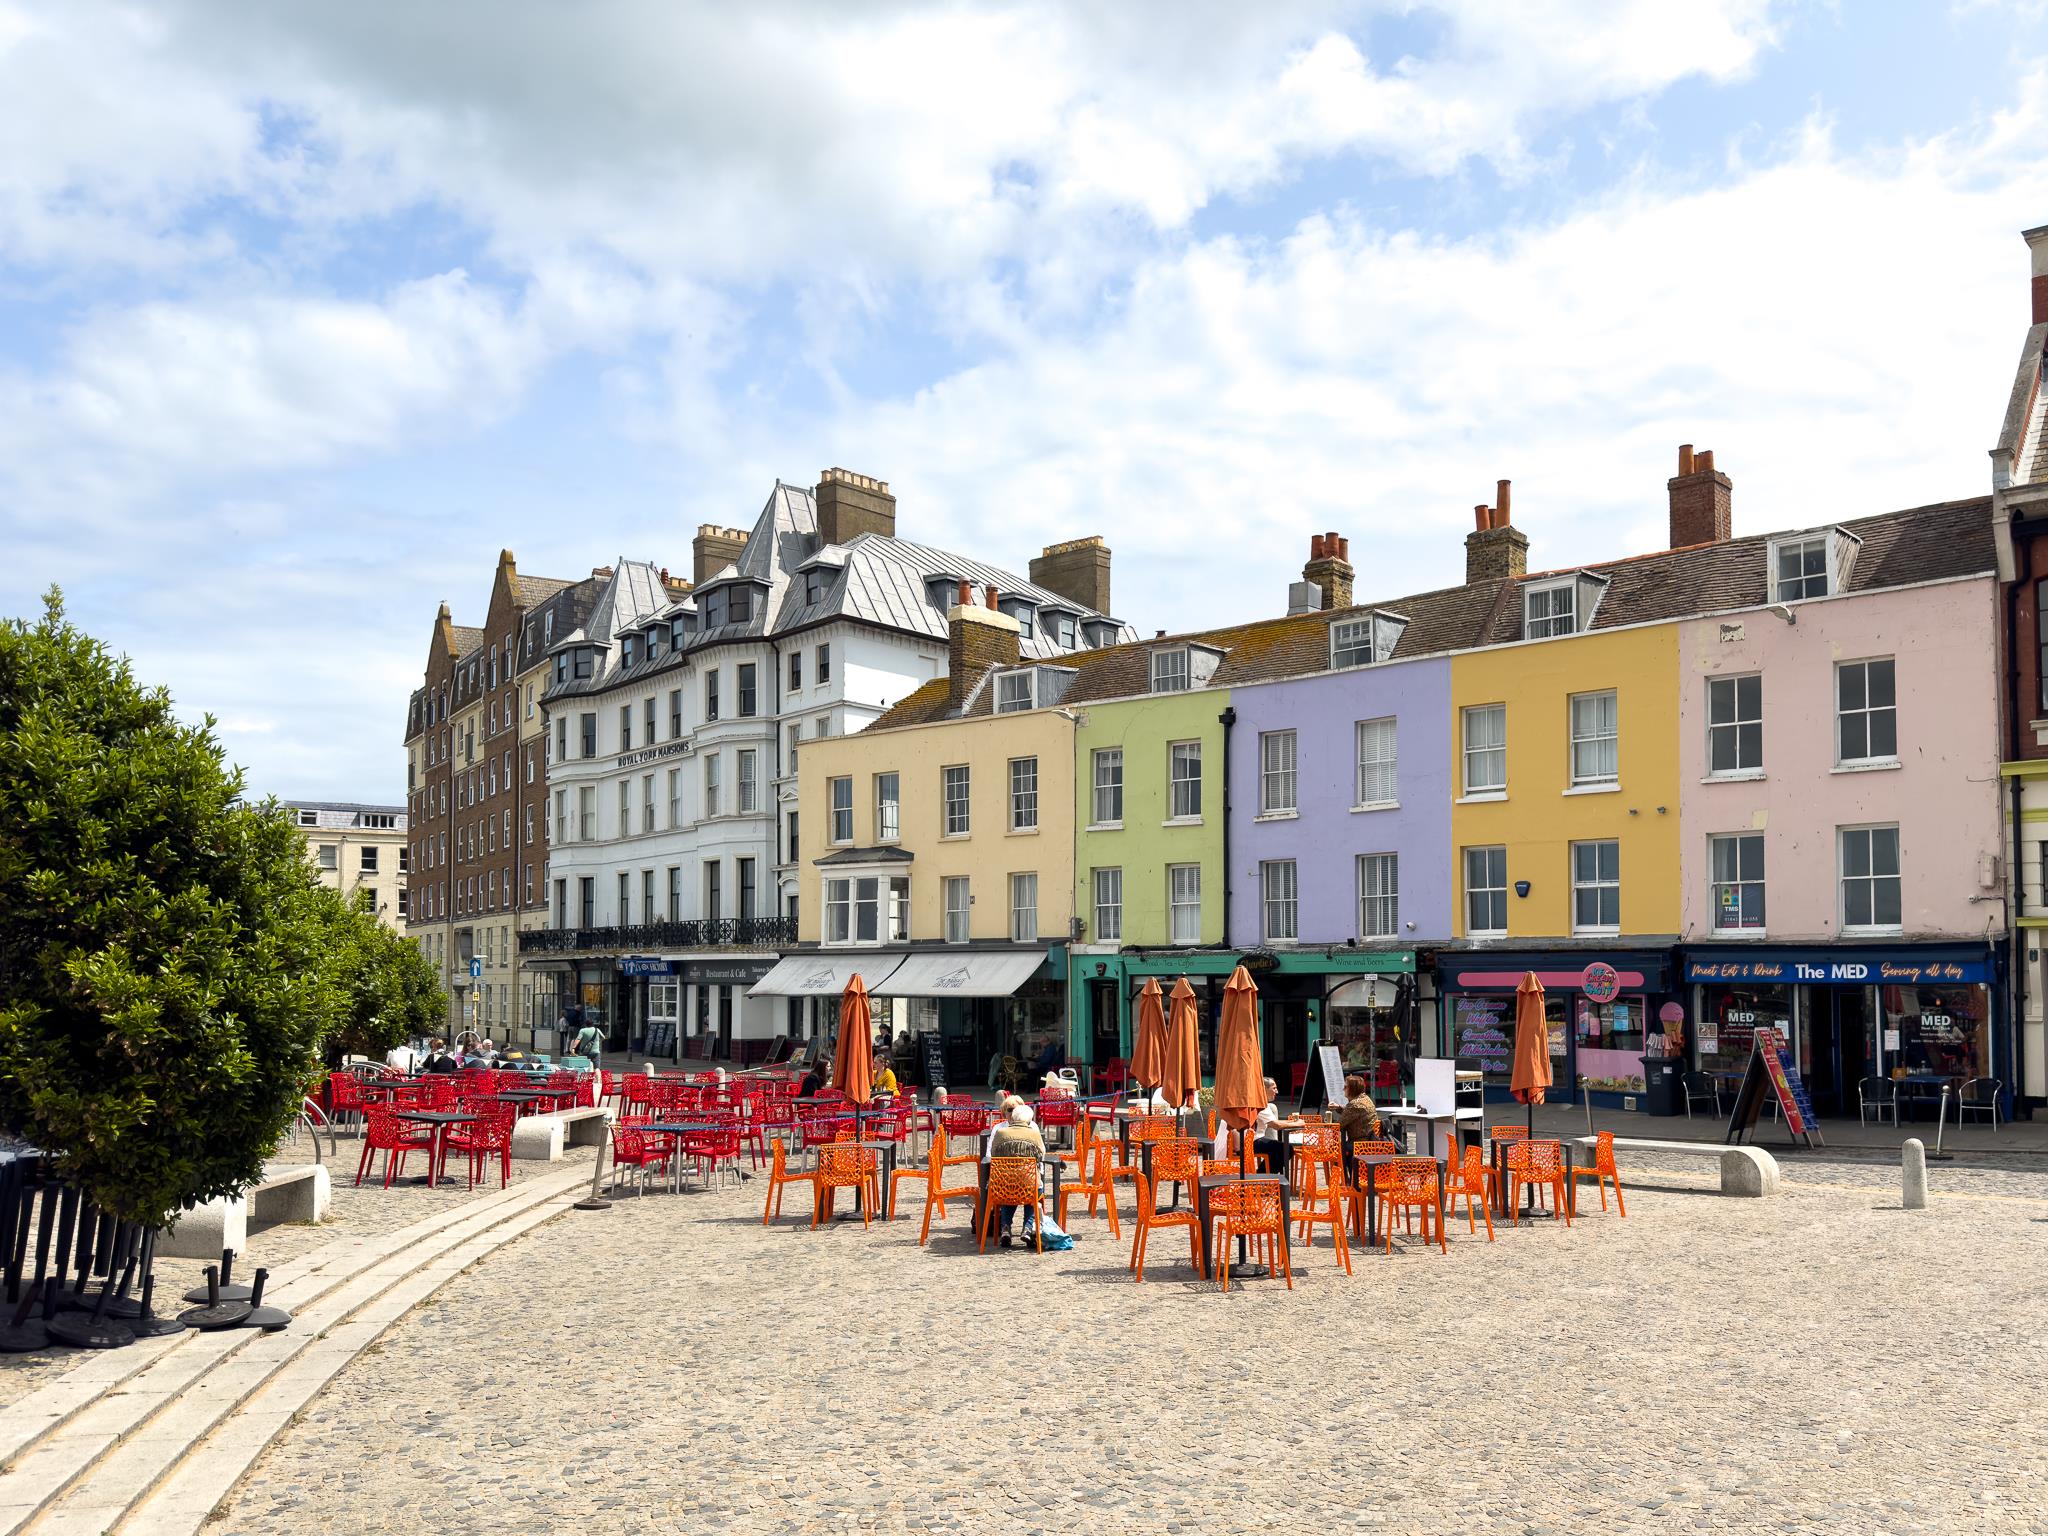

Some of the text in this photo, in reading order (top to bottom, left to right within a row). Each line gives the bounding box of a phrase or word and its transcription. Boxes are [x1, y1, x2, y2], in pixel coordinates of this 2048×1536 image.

[617, 741, 689, 767] ROYAL YORK MANSIONS
[1367, 958, 1385, 966] Beers
[705, 969, 730, 978] Restaurant
[1692, 963, 1783, 976] Meet Eat & Drink
[1795, 963, 1868, 979] The MED
[1881, 962, 1963, 982] Serving all day
[1458, 999, 1476, 1011] Ice
[1728, 1012, 1755, 1022] MED
[1921, 1015, 1951, 1026] MED
[1459, 1043, 1509, 1056] Milkshakes
